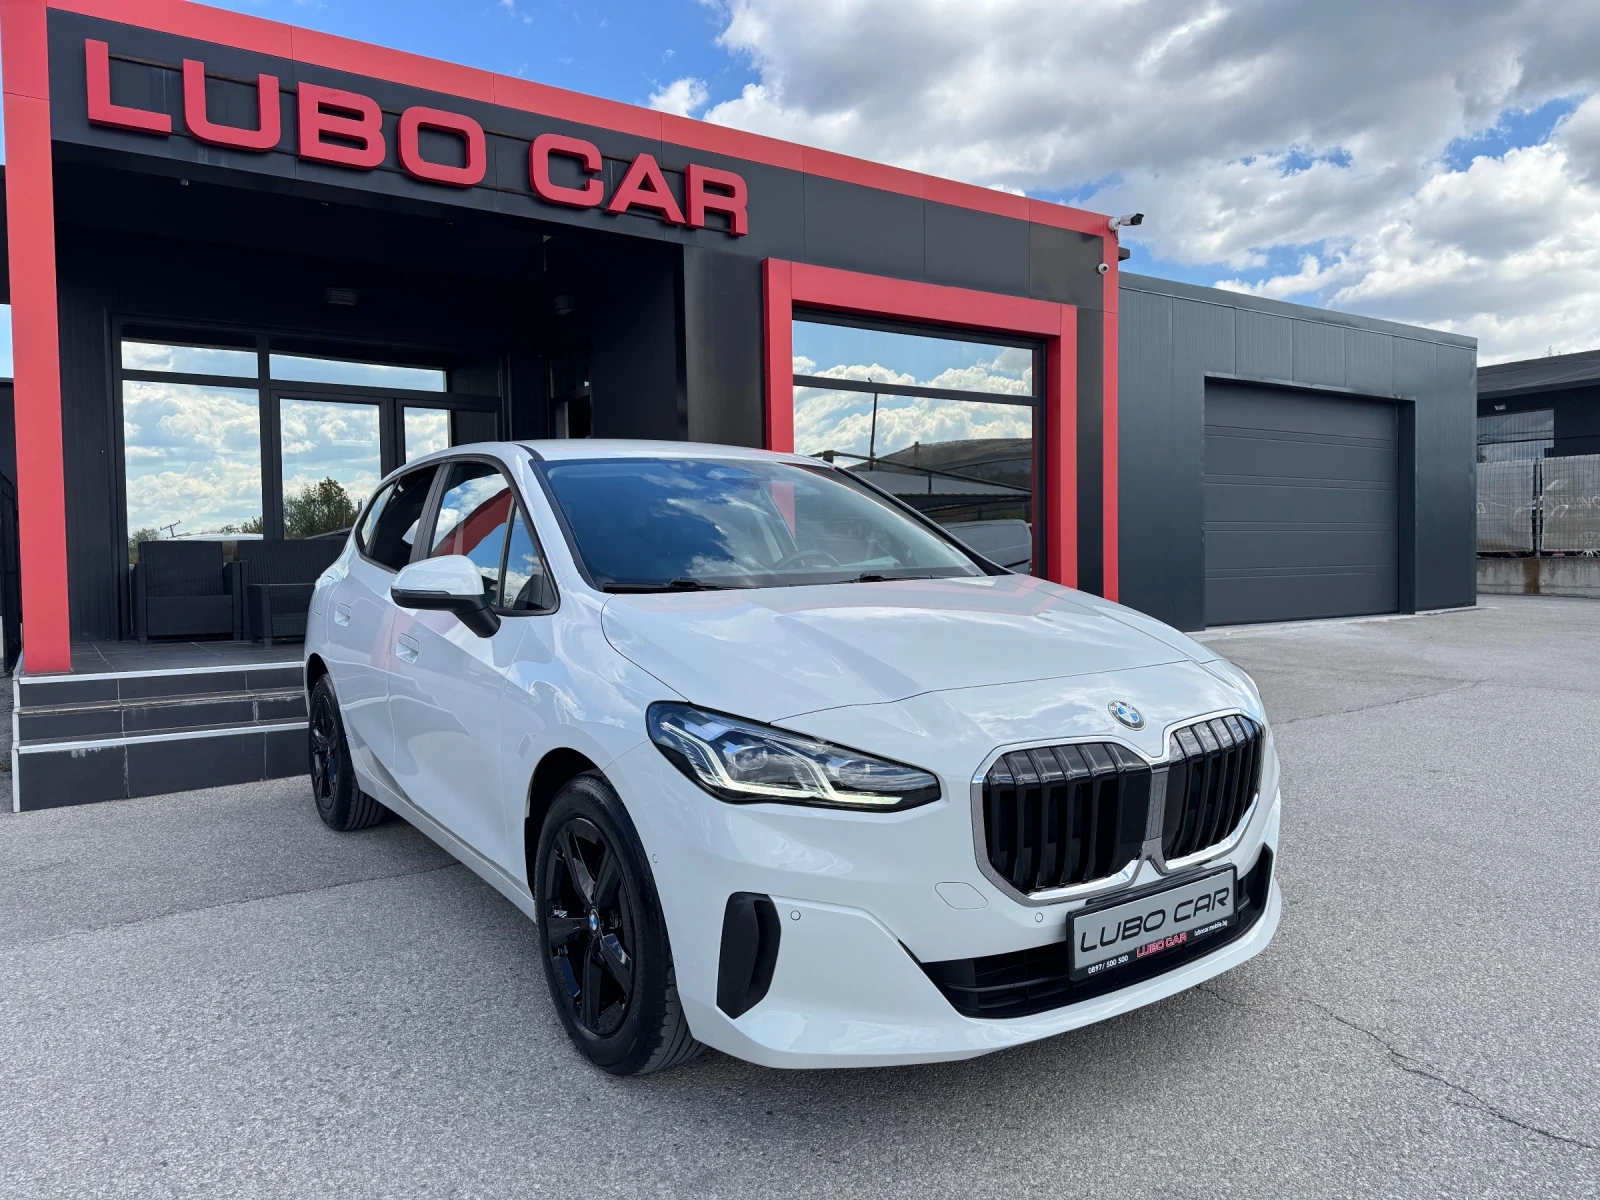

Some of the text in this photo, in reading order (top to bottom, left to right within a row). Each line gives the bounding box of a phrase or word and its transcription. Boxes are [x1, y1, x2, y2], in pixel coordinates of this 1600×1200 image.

[85, 38, 748, 237] LUBO CAR
[1081, 887, 1229, 953] LUBO CAR
[1106, 958, 1117, 968] 500
[1118, 955, 1129, 964] 500
[1136, 932, 1187, 958] LUBO CAR
